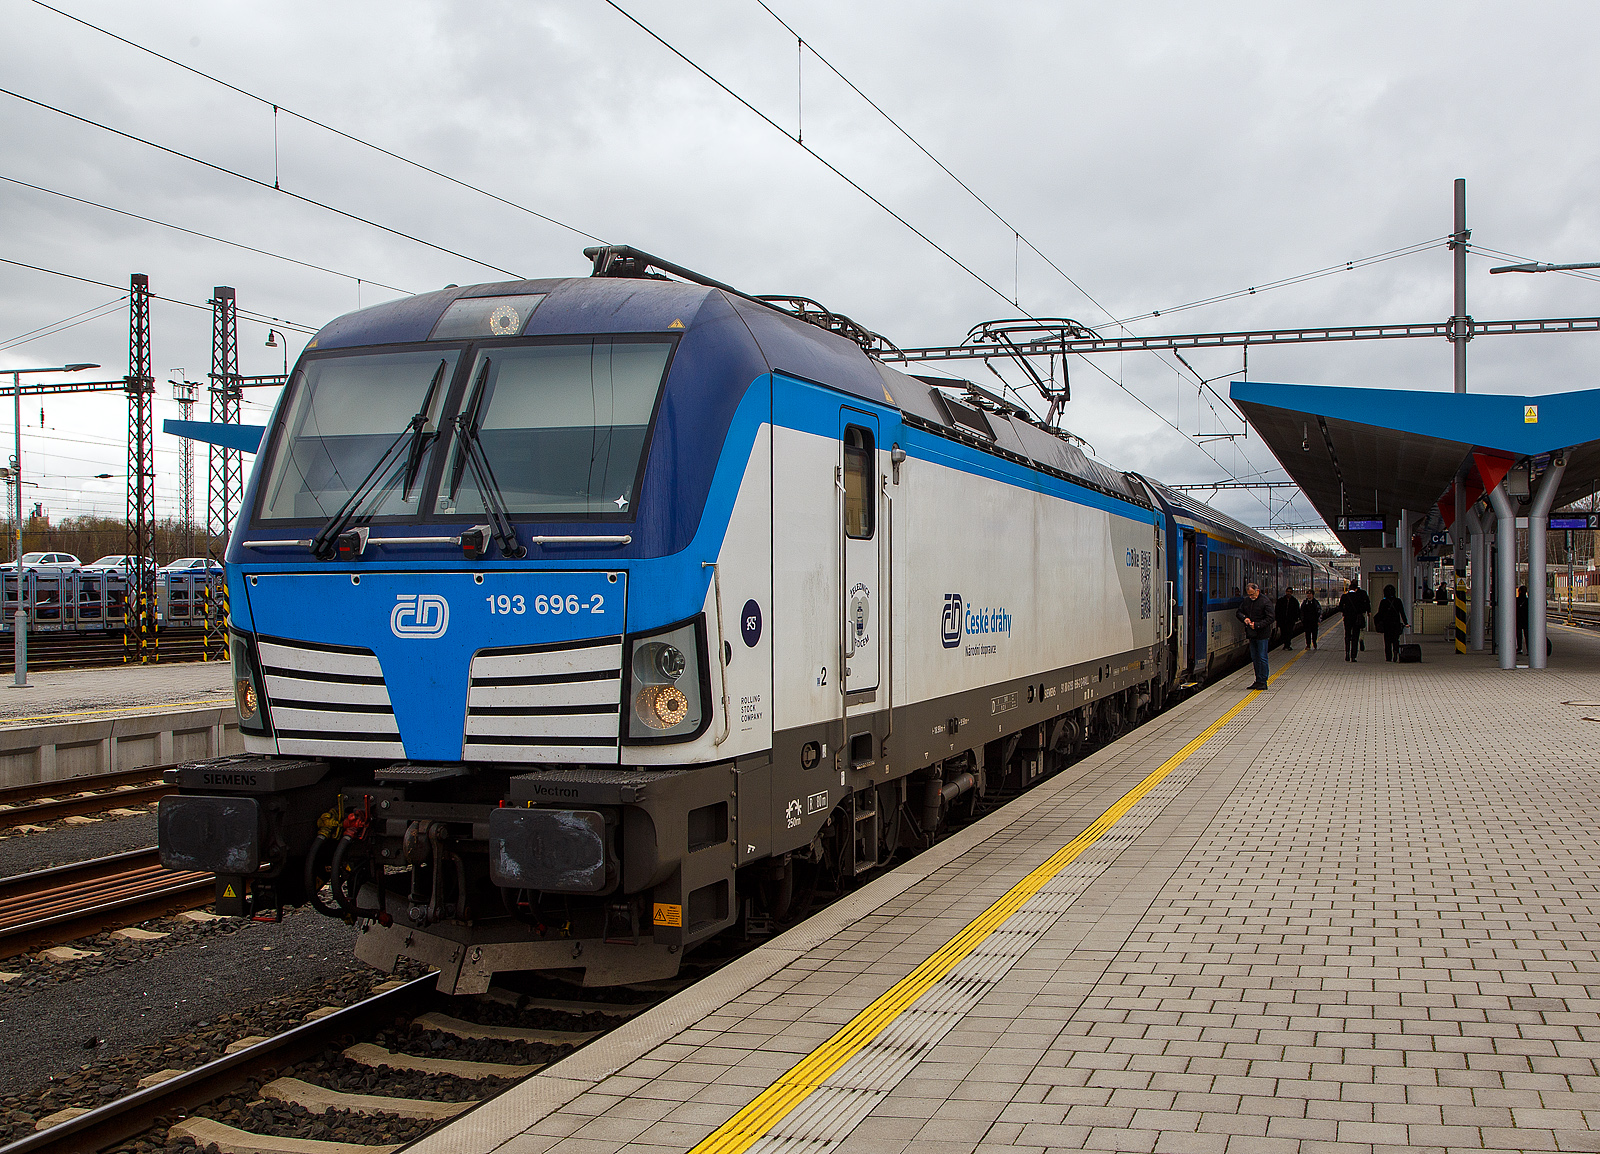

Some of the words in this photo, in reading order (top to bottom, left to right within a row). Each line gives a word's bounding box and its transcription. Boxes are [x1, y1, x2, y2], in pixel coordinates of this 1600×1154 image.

[1338, 517, 1347, 530] 4
[1589, 515, 1598, 528] 2
[1432, 534, 1445, 543] C4
[486, 594, 526, 616] 193
[534, 594, 605, 616] 696-2
[965, 602, 989, 635] České
[990, 606, 1012, 639] dráhy
[965, 643, 980, 657] Národní
[981, 643, 997, 658] dopravce
[820, 666, 828, 686] 2
[740, 694, 761, 705] ROLLING
[740, 704, 756, 714] STOCK
[740, 711, 763, 723] COMPANY
[202, 772, 258, 787] SIEMENS
[533, 783, 580, 799] Vectron
